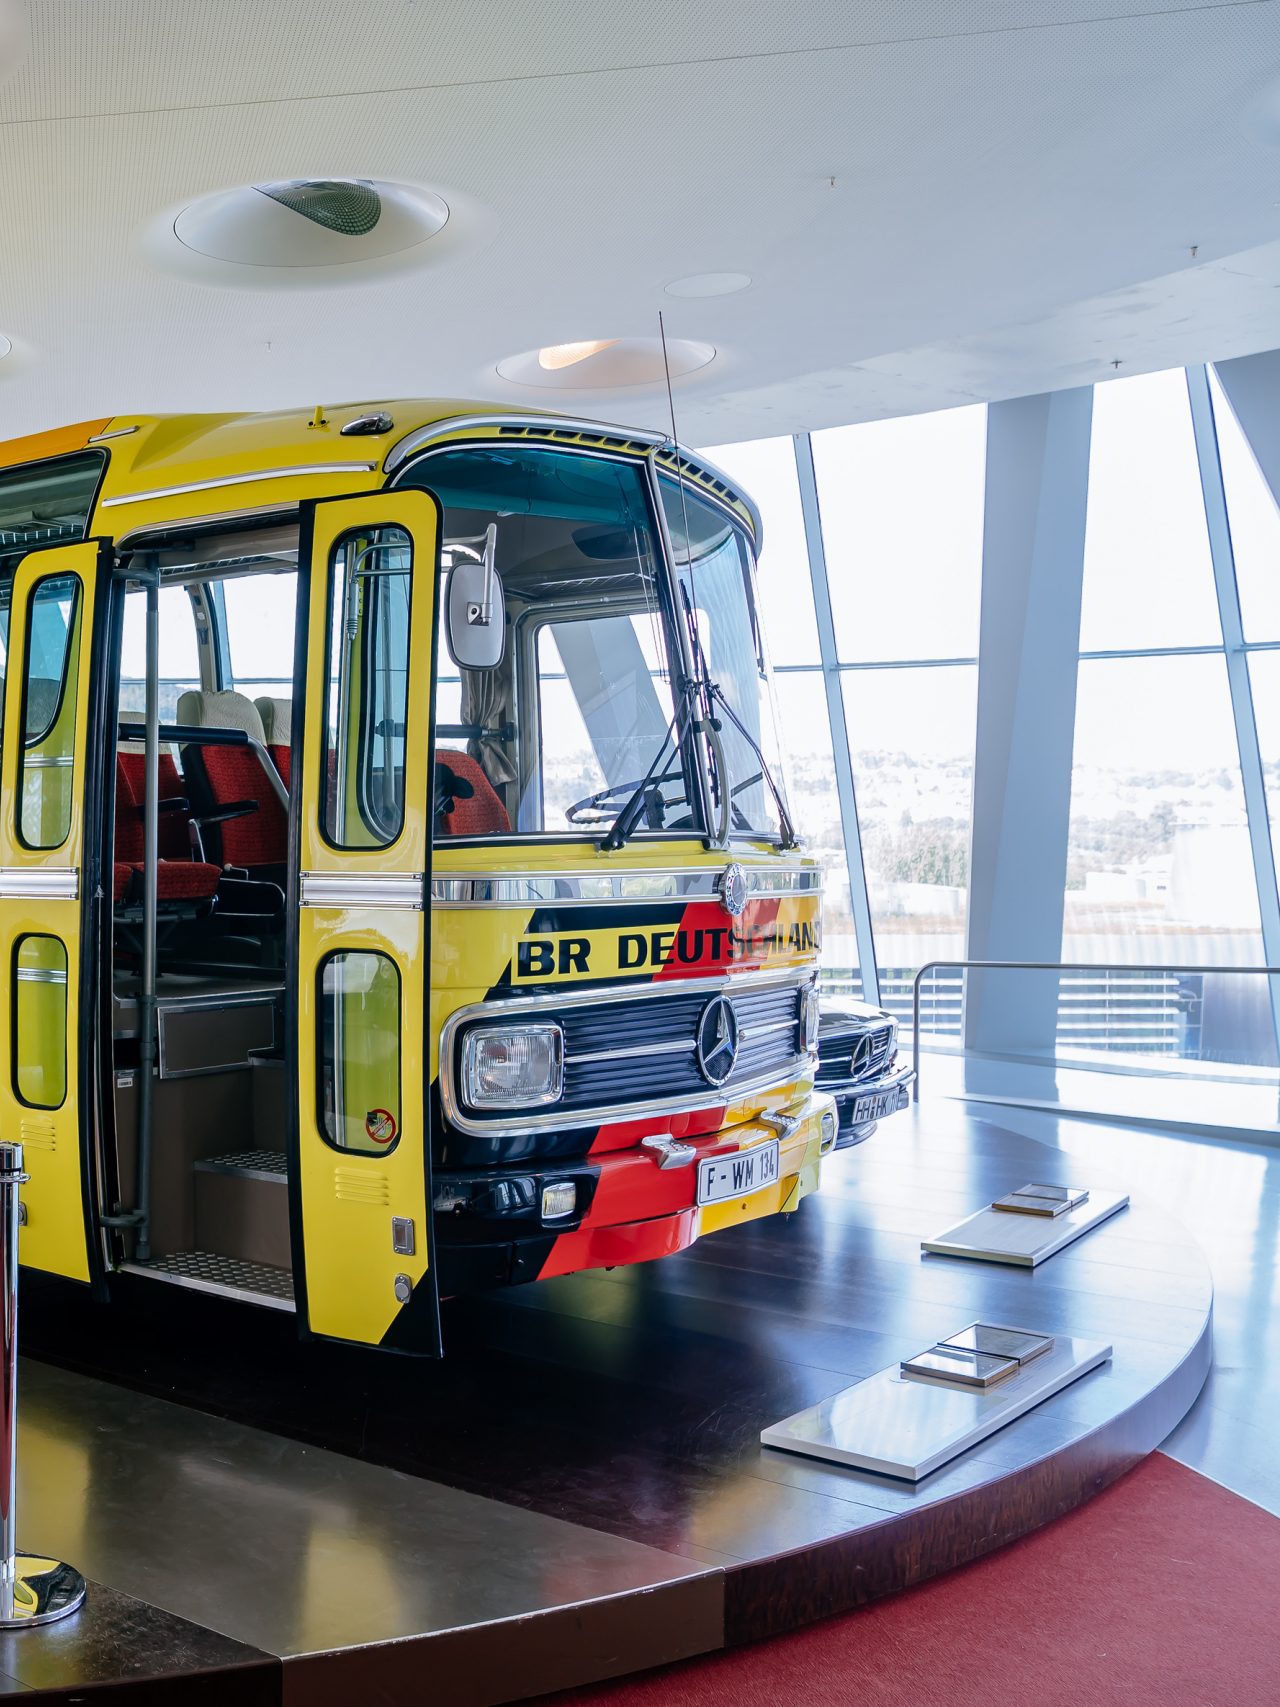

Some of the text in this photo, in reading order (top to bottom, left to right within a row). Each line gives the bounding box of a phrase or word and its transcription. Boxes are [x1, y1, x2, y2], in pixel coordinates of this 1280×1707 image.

[517, 937, 591, 977] BR
[732, 1157, 755, 1190] WM
[760, 1148, 775, 1181] 134
